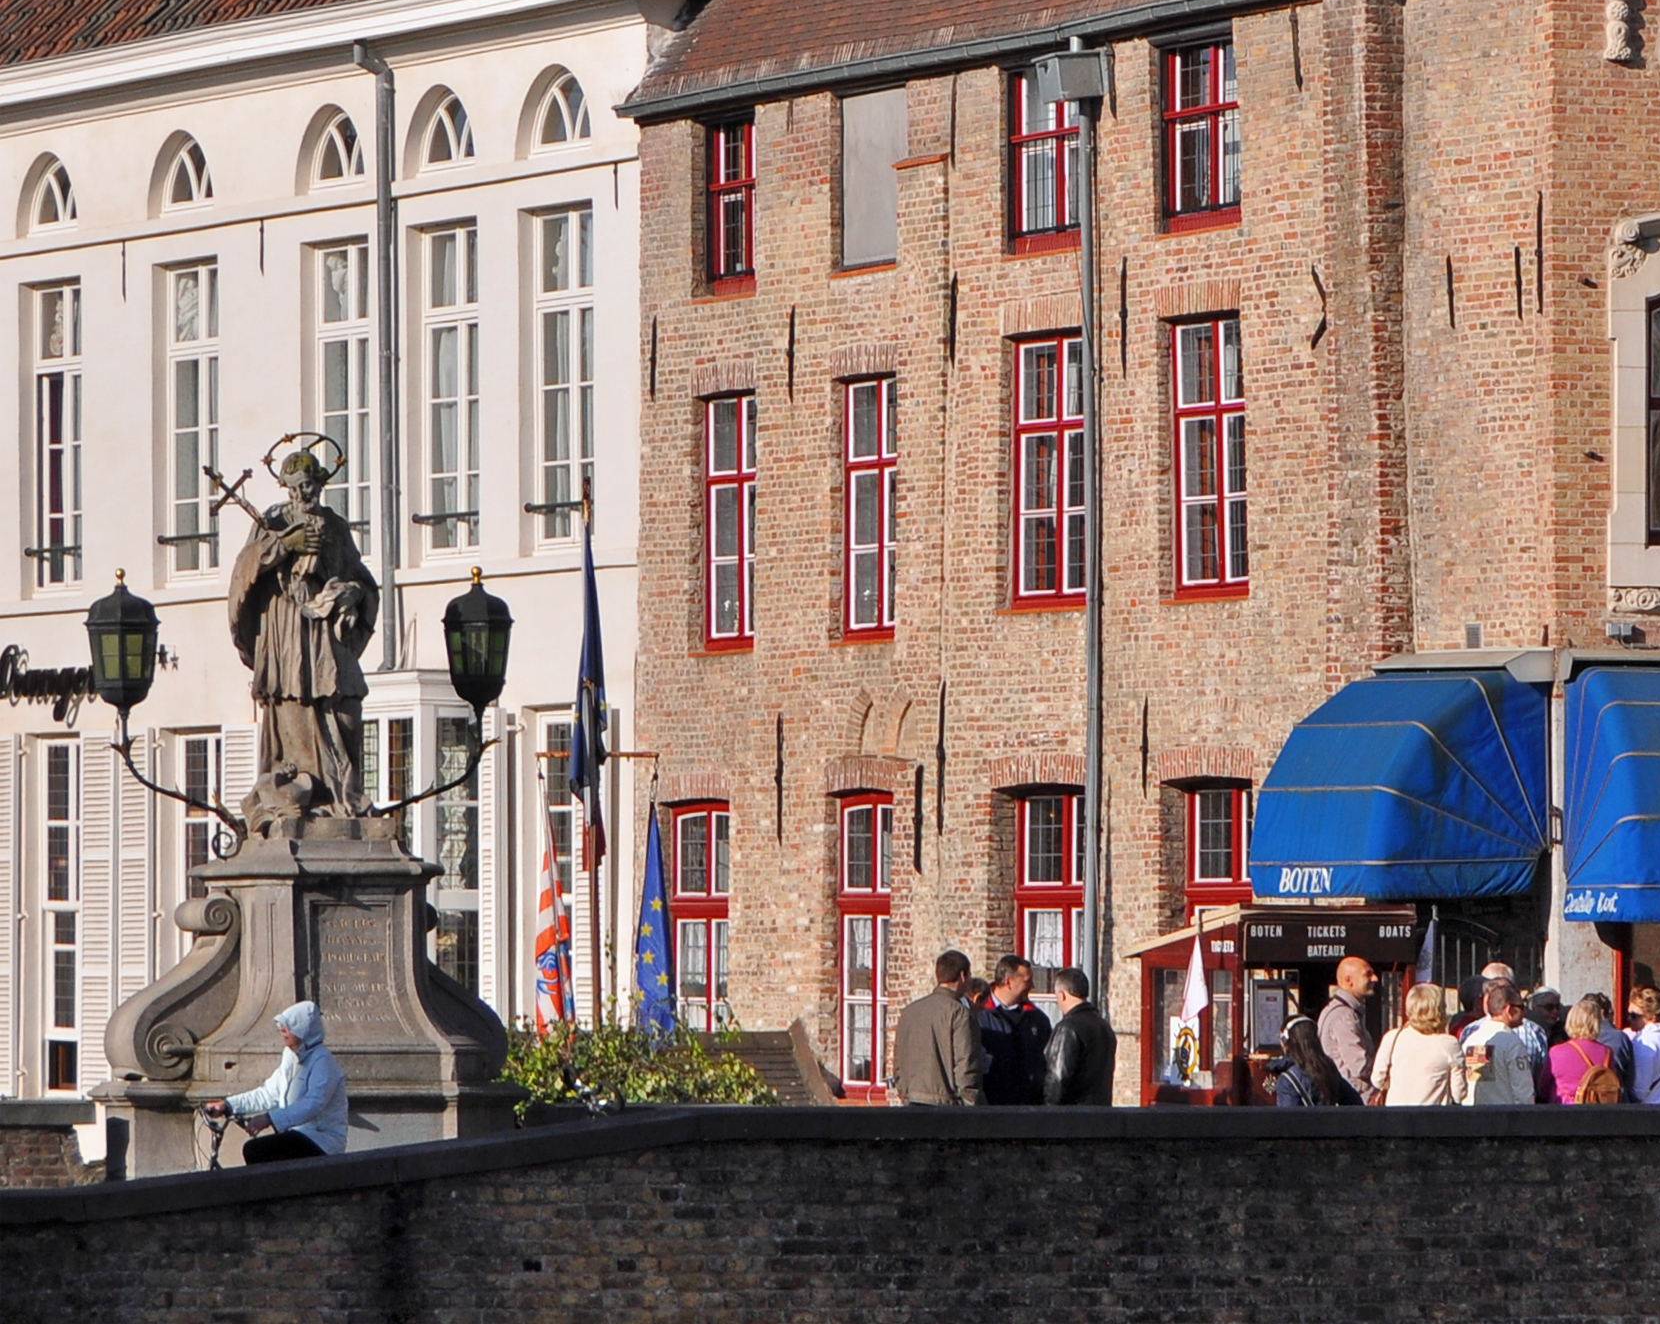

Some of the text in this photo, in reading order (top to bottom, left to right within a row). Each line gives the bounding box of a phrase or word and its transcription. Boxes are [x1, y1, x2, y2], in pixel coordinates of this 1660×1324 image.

[1278, 866, 1334, 894] BOTEN
[1250, 924, 1412, 938] BOTEN TICKETS BOATS
[1306, 944, 1346, 958] BATEAUX
